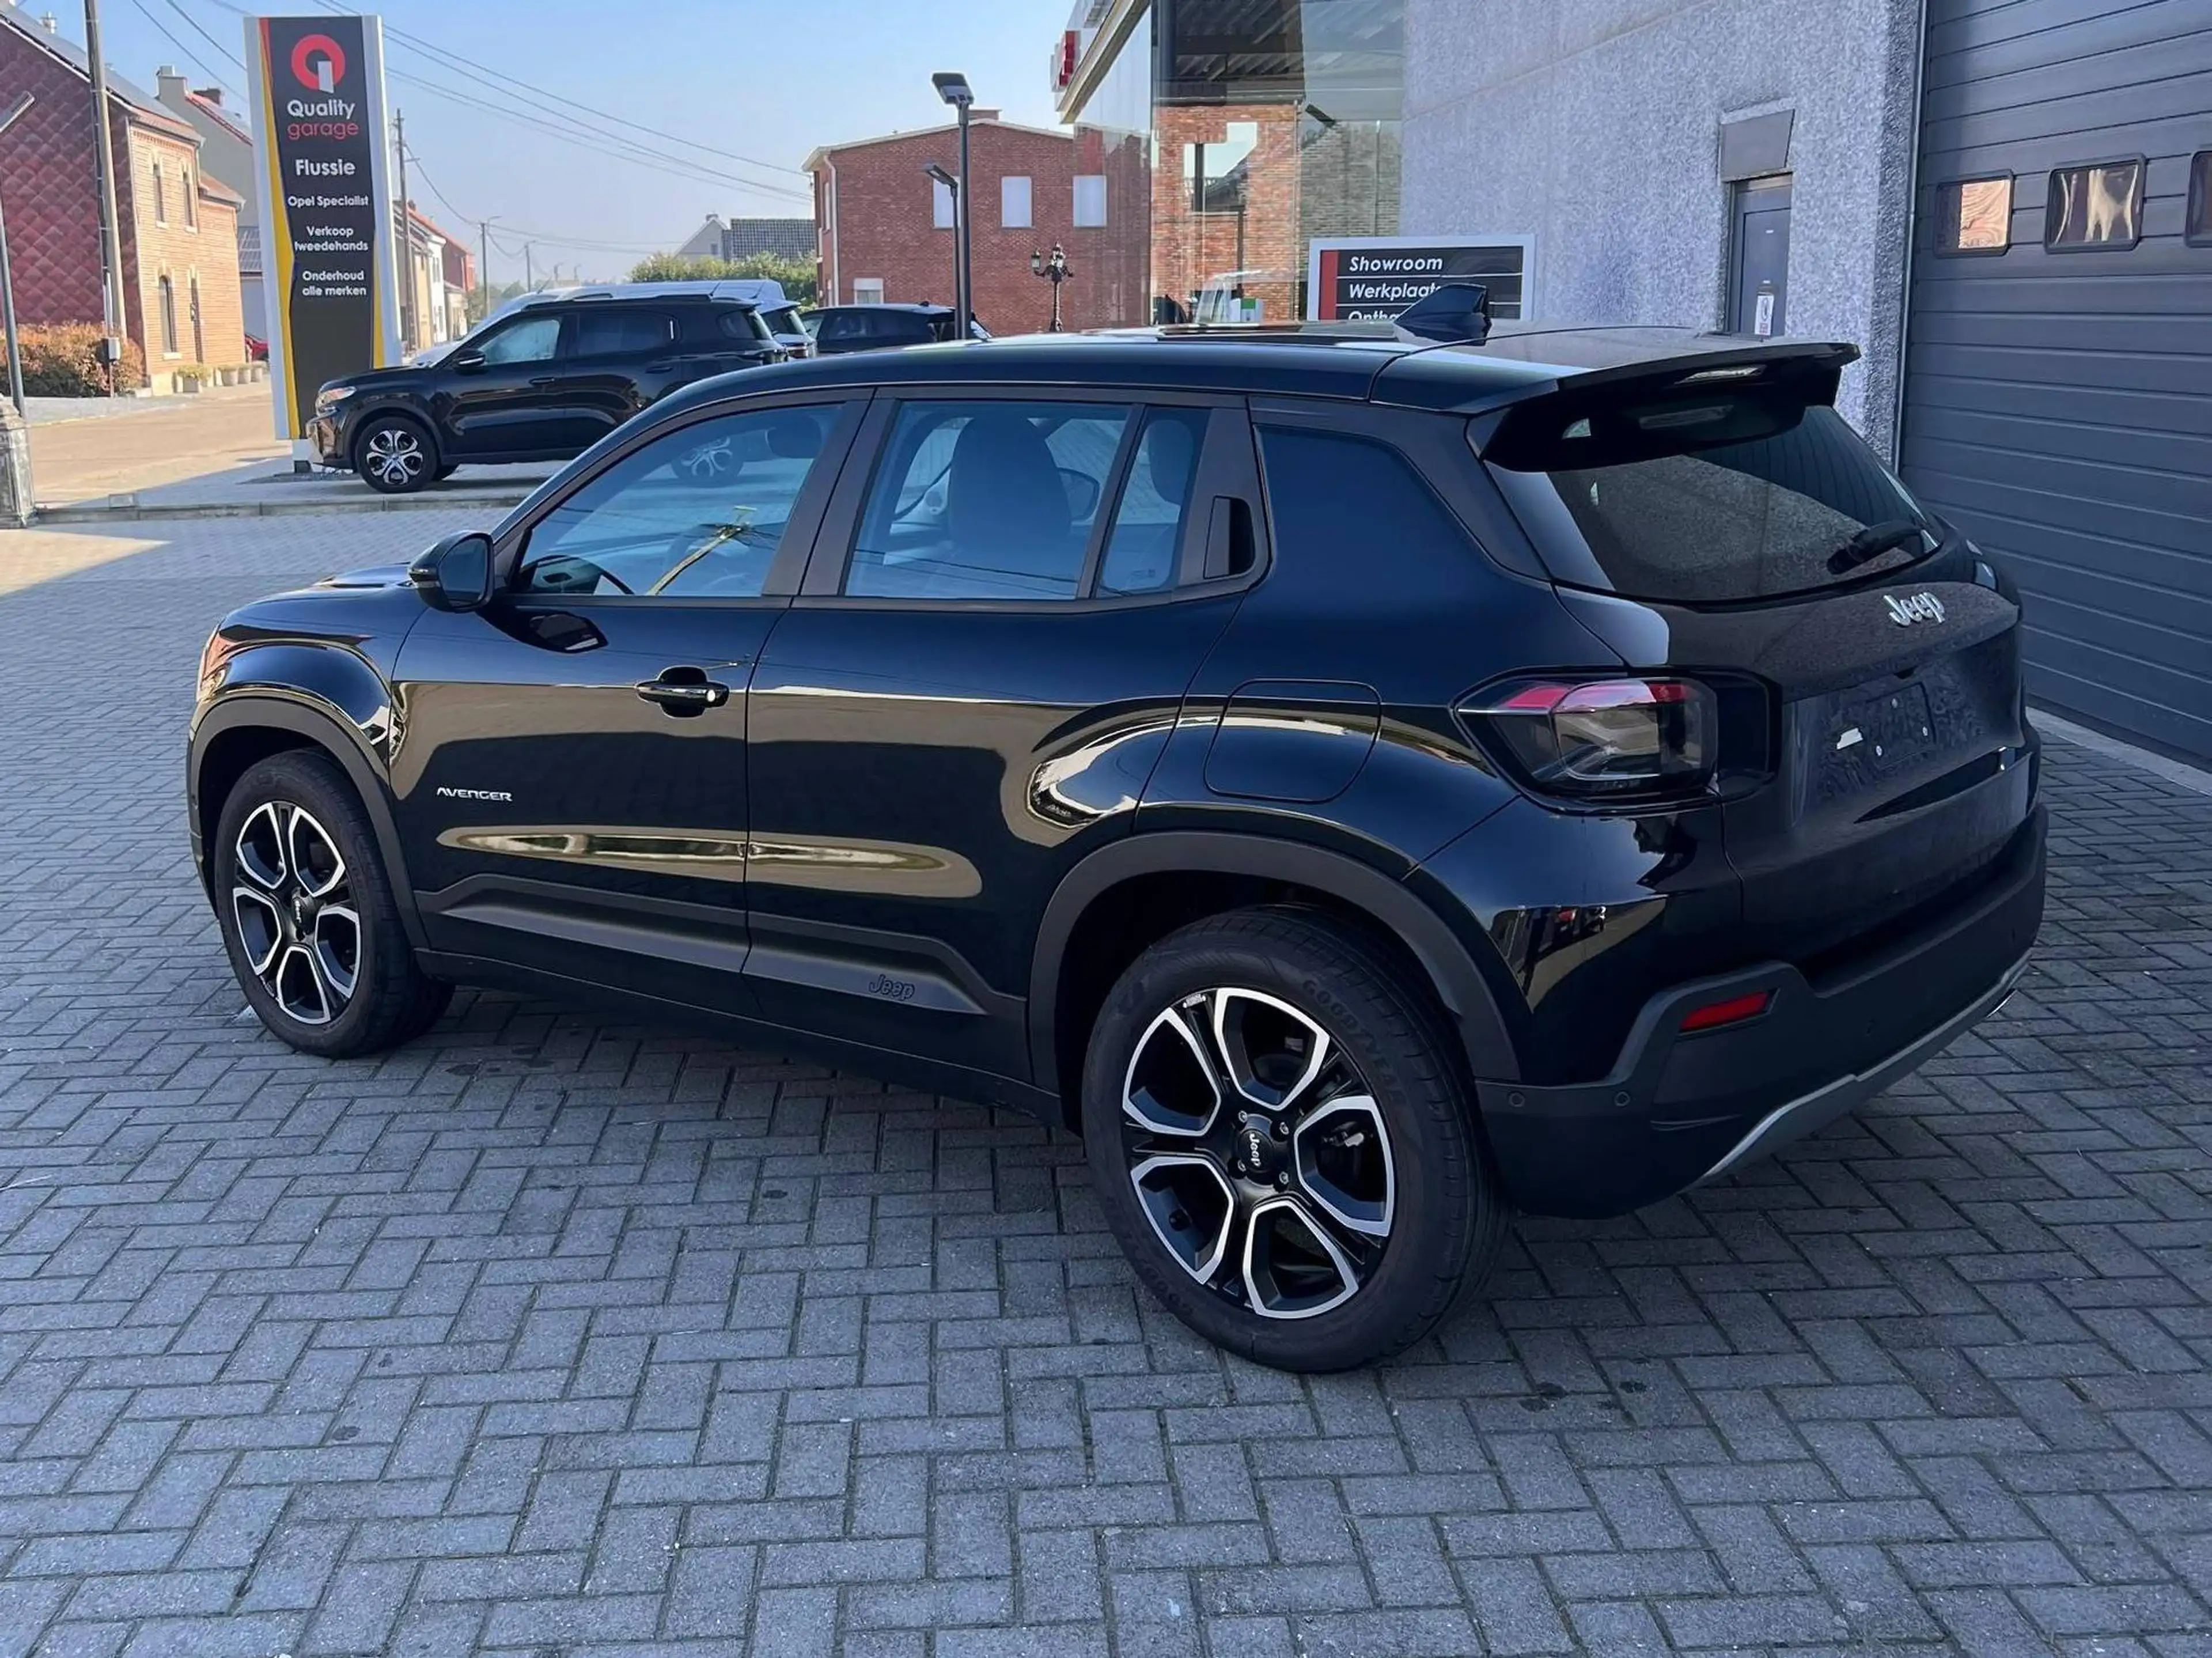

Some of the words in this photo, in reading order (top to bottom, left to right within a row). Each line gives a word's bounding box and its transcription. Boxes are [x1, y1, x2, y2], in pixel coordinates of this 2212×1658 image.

[287, 99, 355, 120] Quality
[287, 123, 359, 141] garage
[295, 158, 356, 176] Flussie
[287, 195, 315, 208] Opel
[316, 195, 369, 208] Specialist
[306, 226, 354, 237] Verkoop
[294, 241, 369, 252] tweedehands
[1349, 256, 1443, 272] Showroom
[302, 270, 365, 281] Onderhoud
[302, 285, 323, 296] alle
[324, 286, 367, 296] merken
[1883, 591, 1946, 626] Jeep
[436, 786, 513, 802] AVENGER
[869, 974, 916, 1001] Jeep
[1249, 1133, 1262, 1167] Jeep
